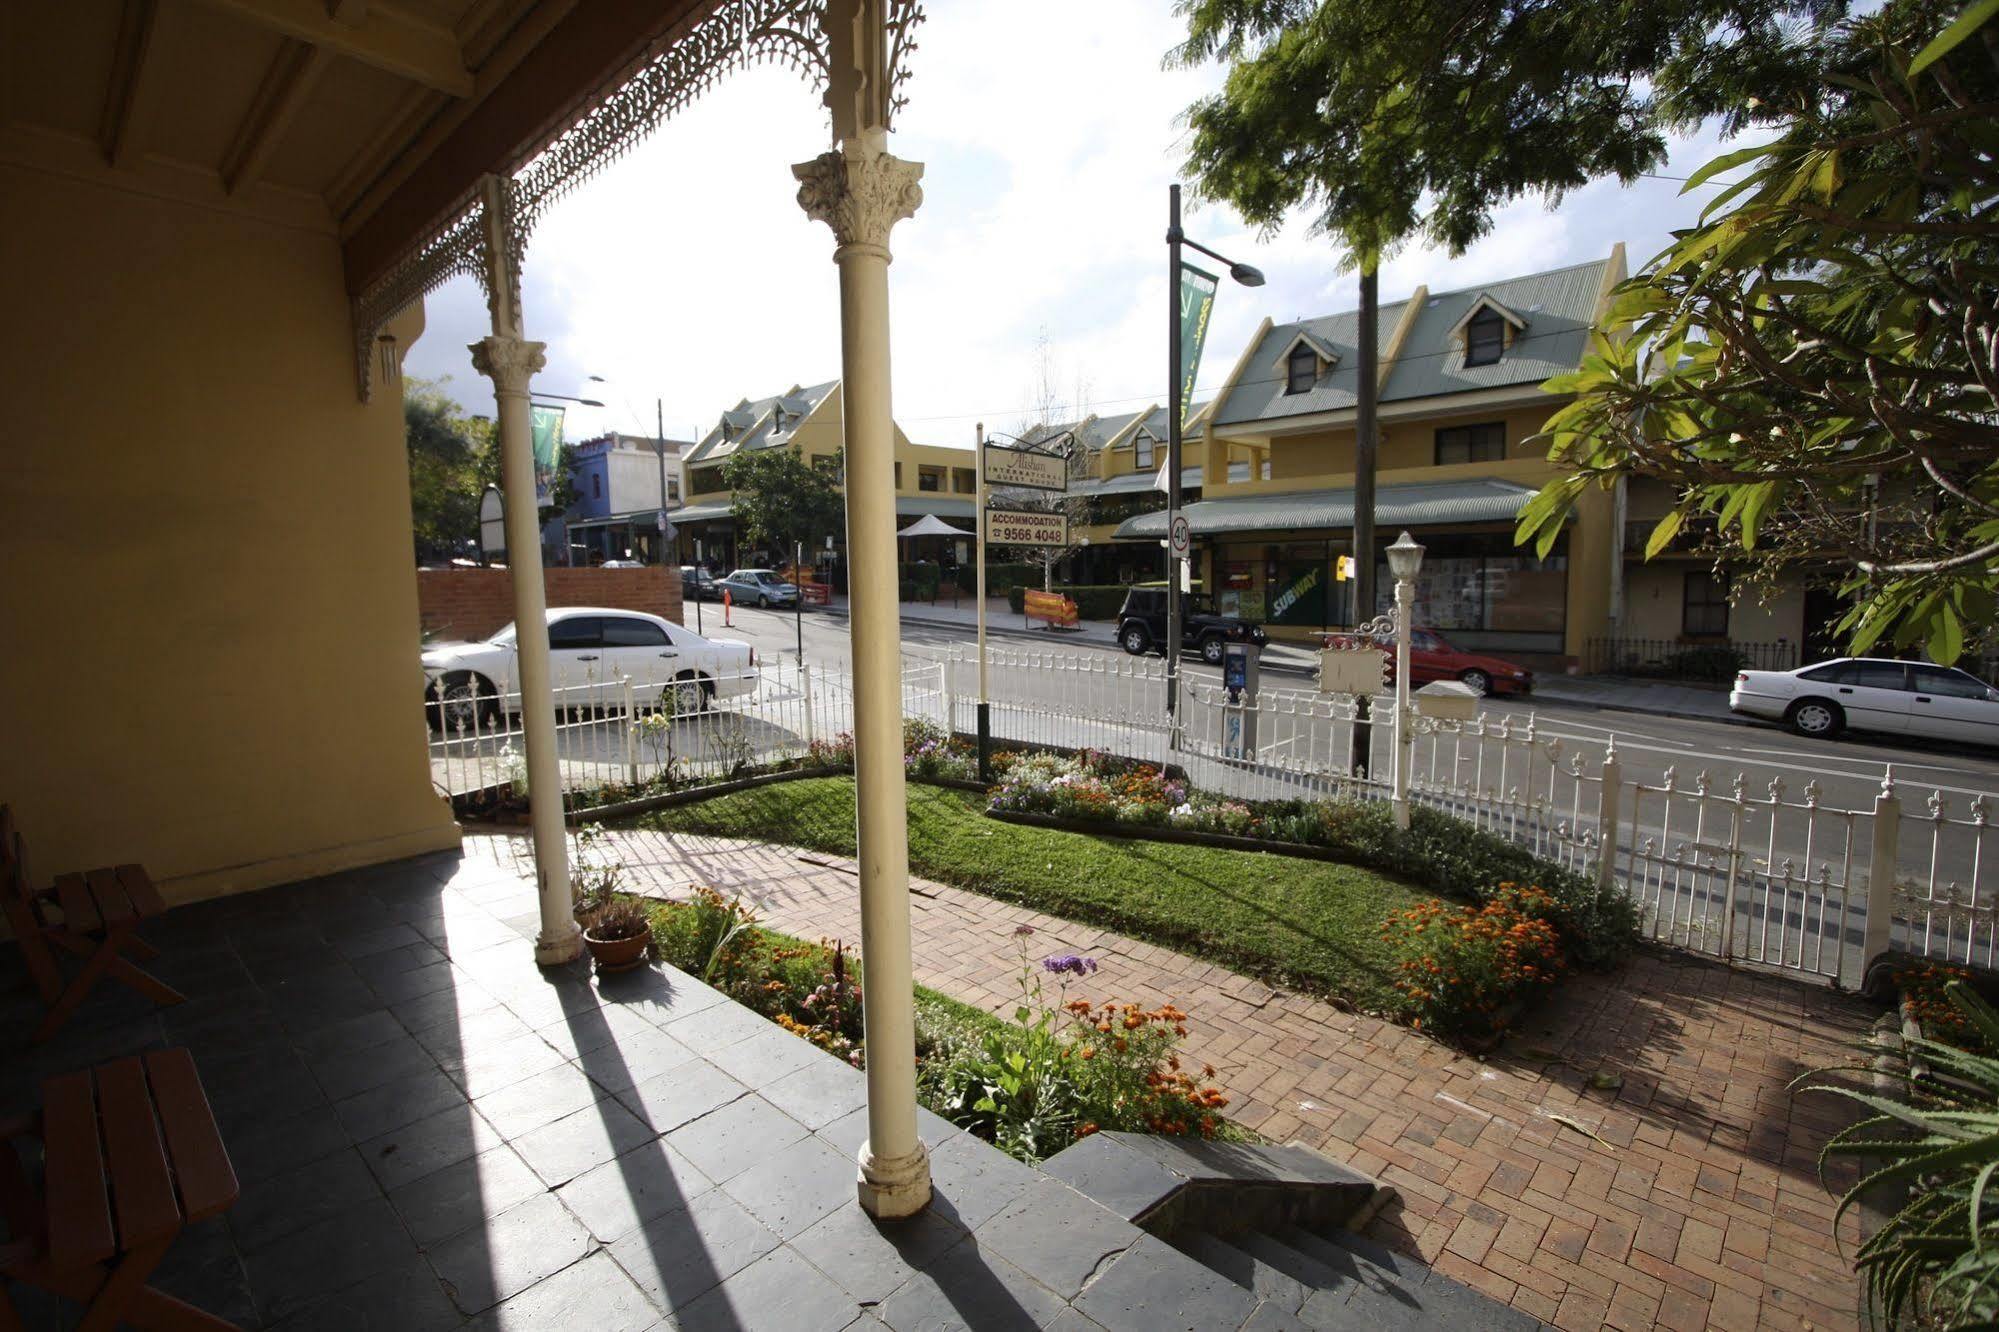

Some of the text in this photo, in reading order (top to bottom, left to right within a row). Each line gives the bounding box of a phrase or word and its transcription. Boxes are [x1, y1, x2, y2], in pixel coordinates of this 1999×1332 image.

[988, 466, 1062, 480] INTERNATIONAL
[992, 514, 1062, 527] ACCOMMODATION
[1004, 528, 1062, 543] 9566 4048
[1174, 526, 1186, 542] 40
[1273, 567, 1319, 617] SUBWAY
